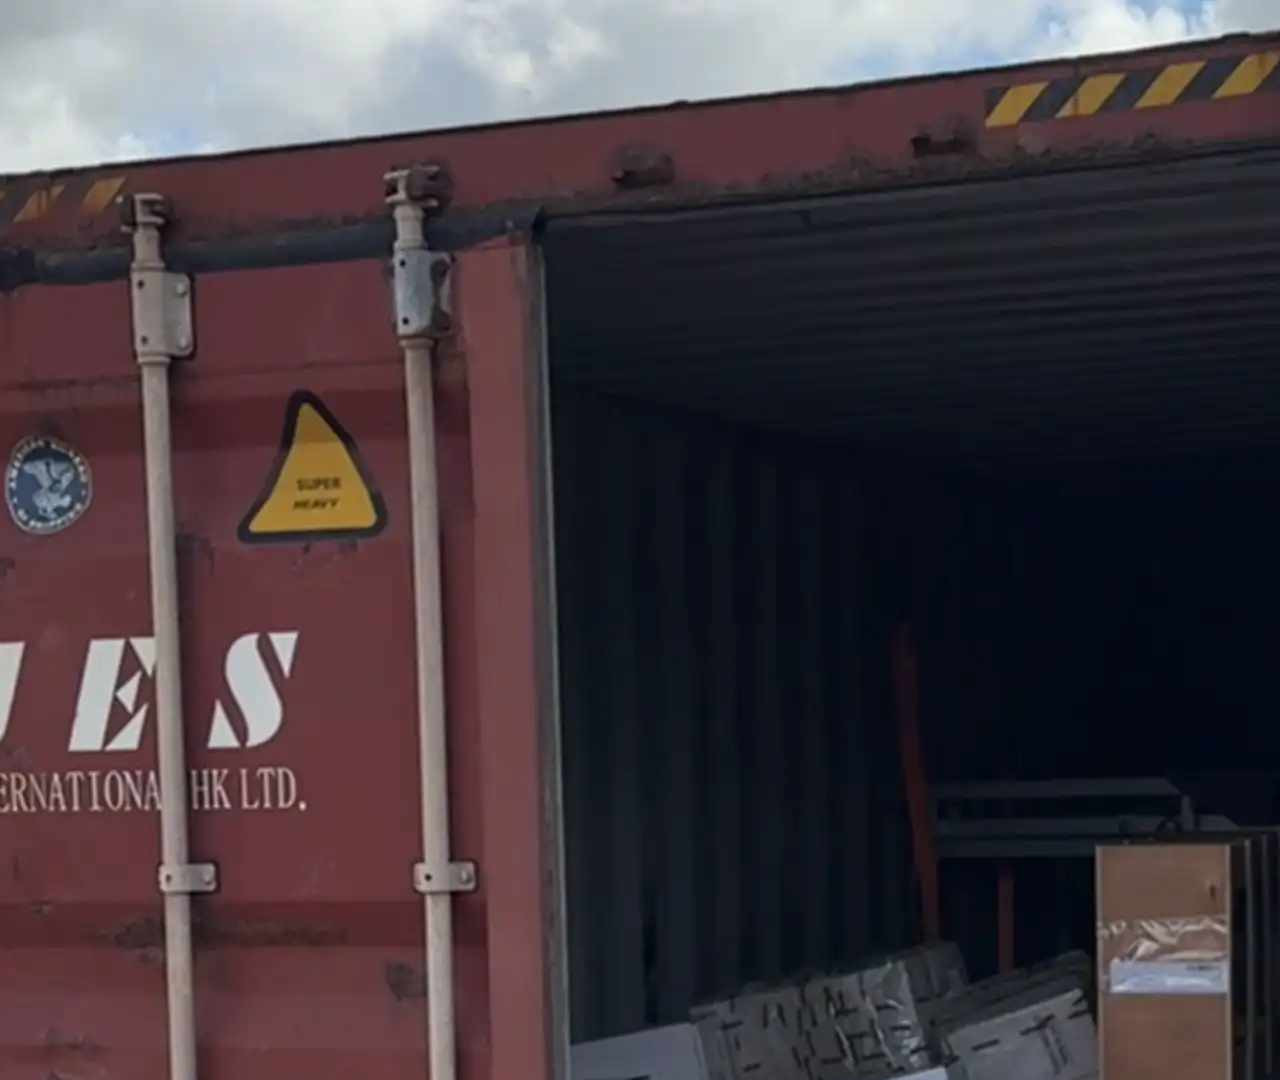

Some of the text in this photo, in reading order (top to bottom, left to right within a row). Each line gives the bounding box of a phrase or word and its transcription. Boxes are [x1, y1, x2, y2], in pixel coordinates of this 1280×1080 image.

[296, 477, 341, 492] SUPER
[293, 498, 339, 511] HEAVY
[241, 766, 307, 811] LTD.
